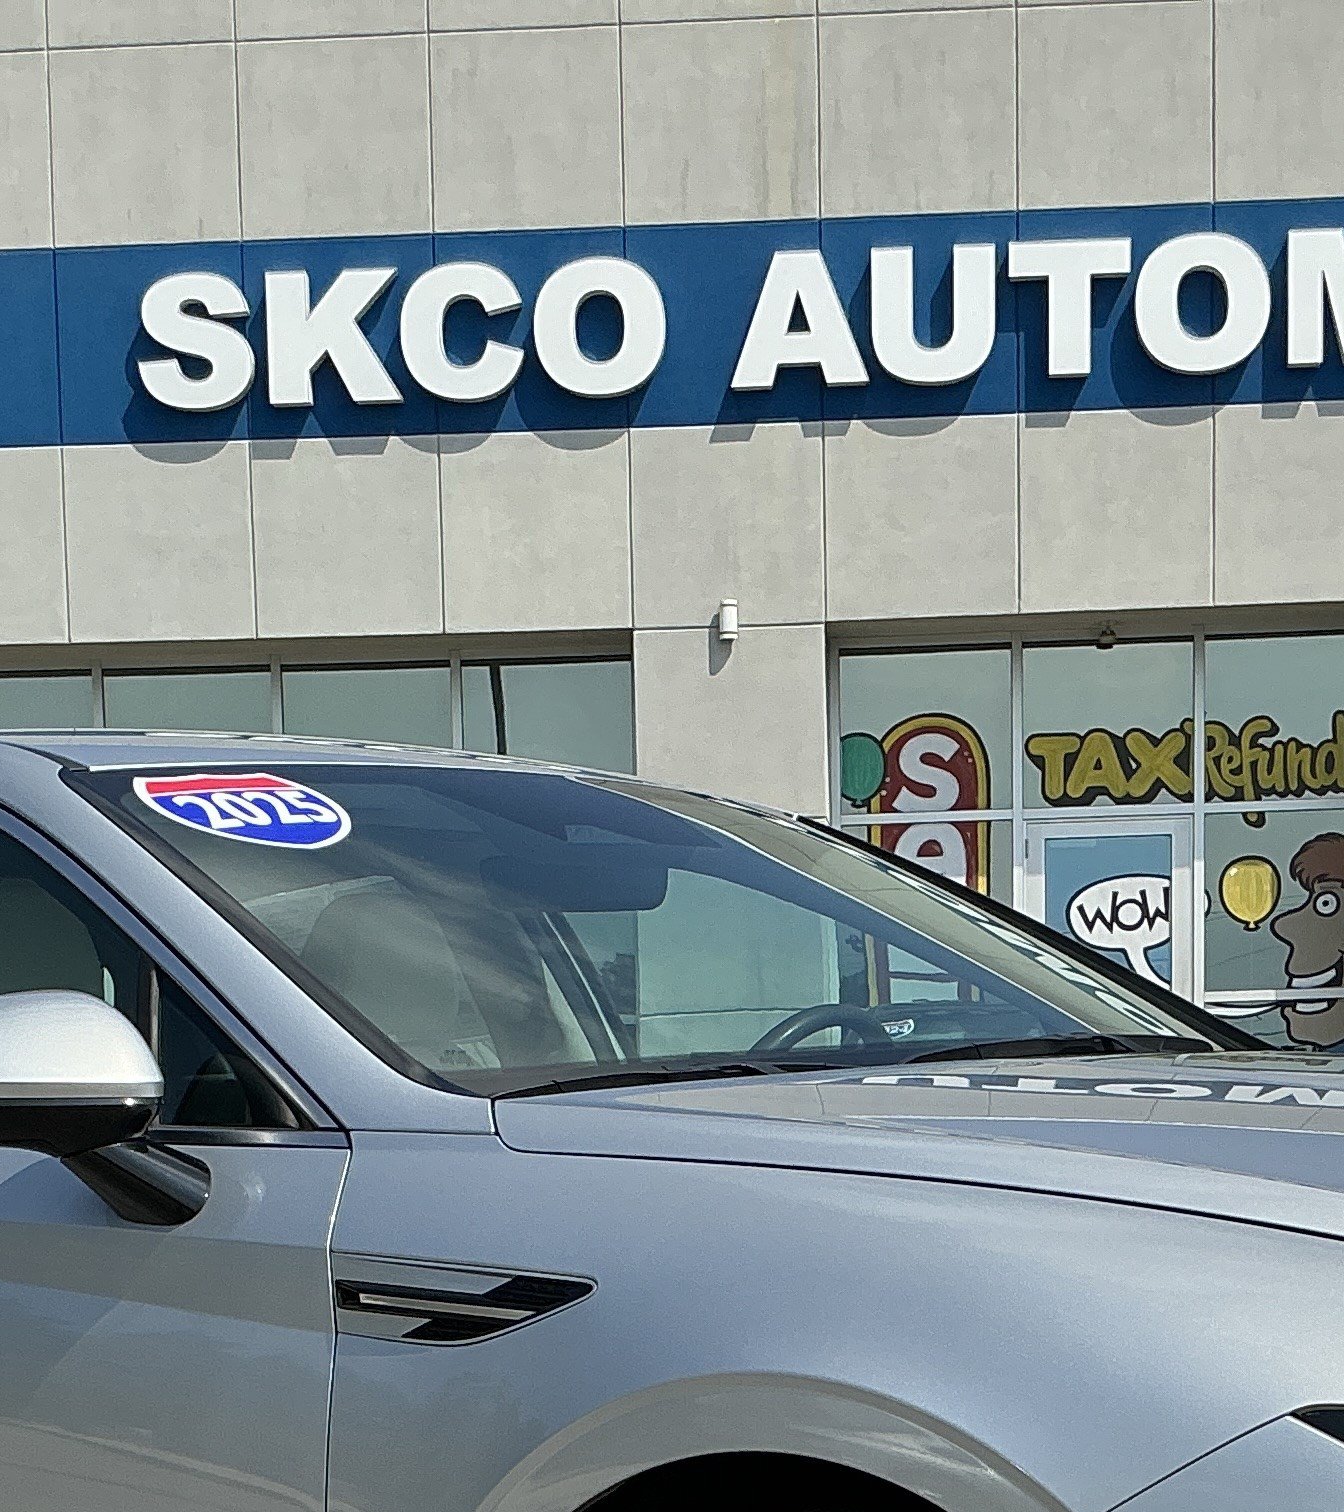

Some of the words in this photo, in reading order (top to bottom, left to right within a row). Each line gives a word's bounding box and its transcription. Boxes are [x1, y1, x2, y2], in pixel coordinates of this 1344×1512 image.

[139, 255, 667, 412] SKCO
[1026, 729, 1193, 802] TAX
[171, 789, 340, 830] 2025
[1076, 886, 1170, 934] WOW
